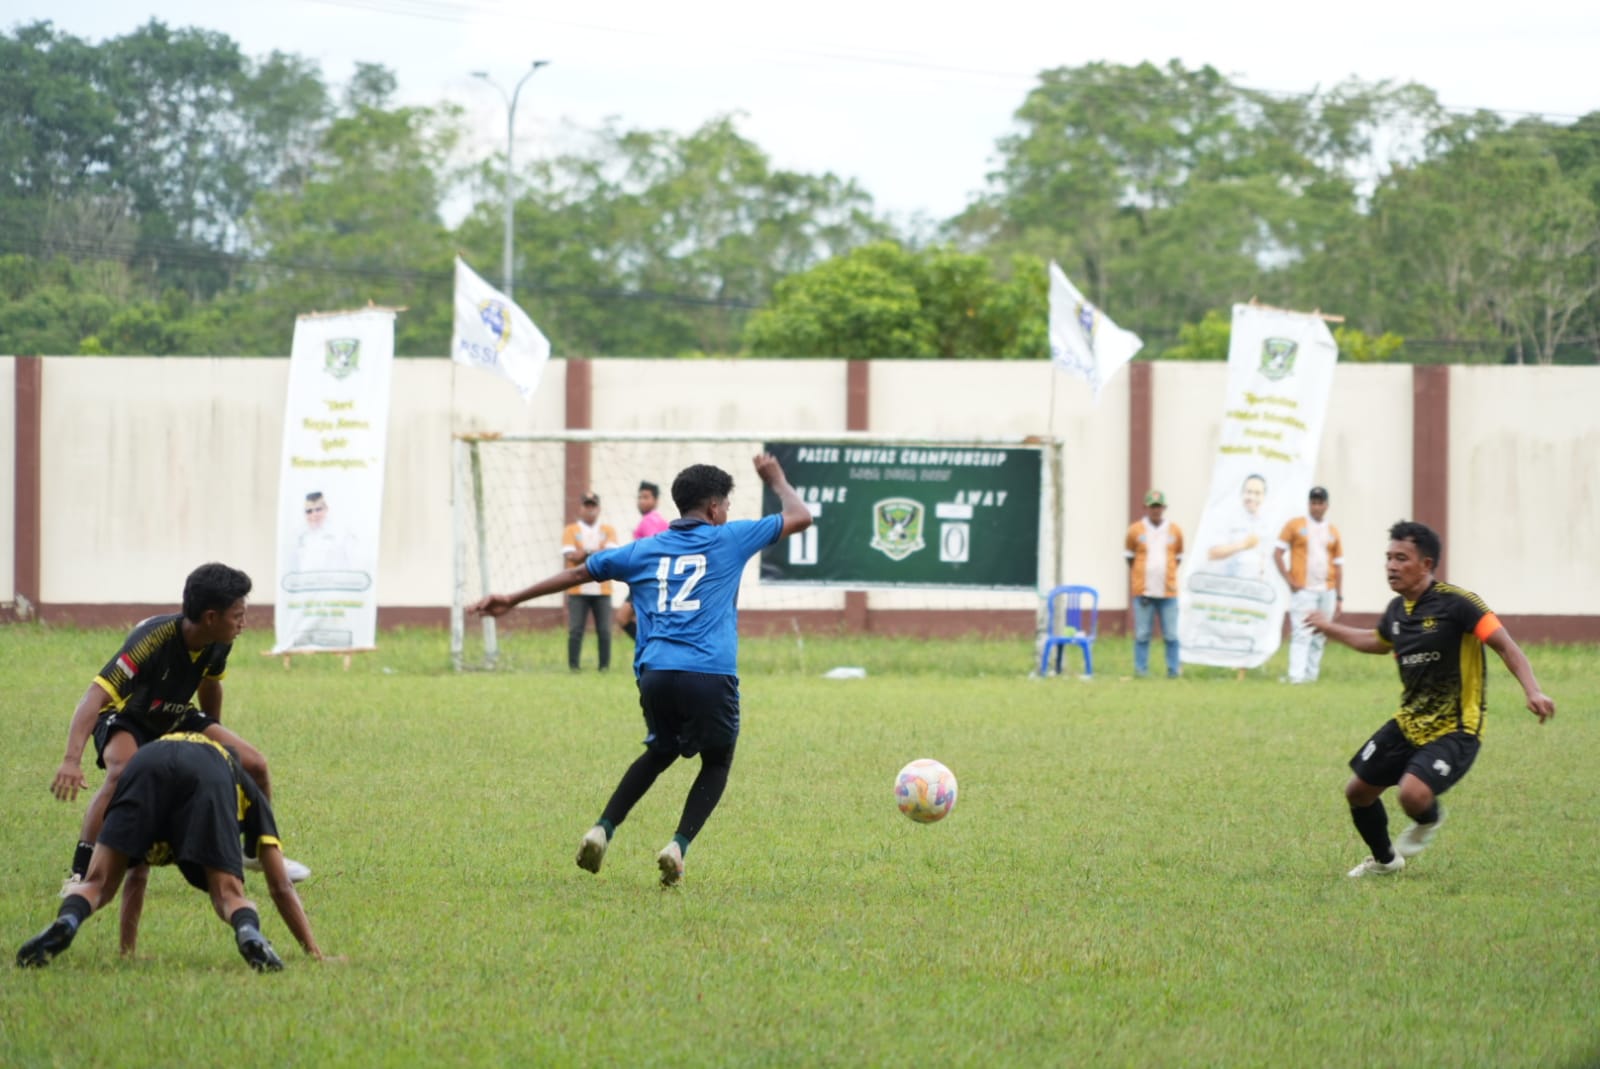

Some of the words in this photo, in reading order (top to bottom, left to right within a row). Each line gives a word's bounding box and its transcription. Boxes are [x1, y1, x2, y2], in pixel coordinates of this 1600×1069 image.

[797, 447, 840, 463] PASER
[844, 448, 897, 465] TUNTAS
[899, 449, 1008, 467] CHAMPIONSHIP
[954, 490, 1009, 507] AWAY
[656, 554, 707, 612] 12
